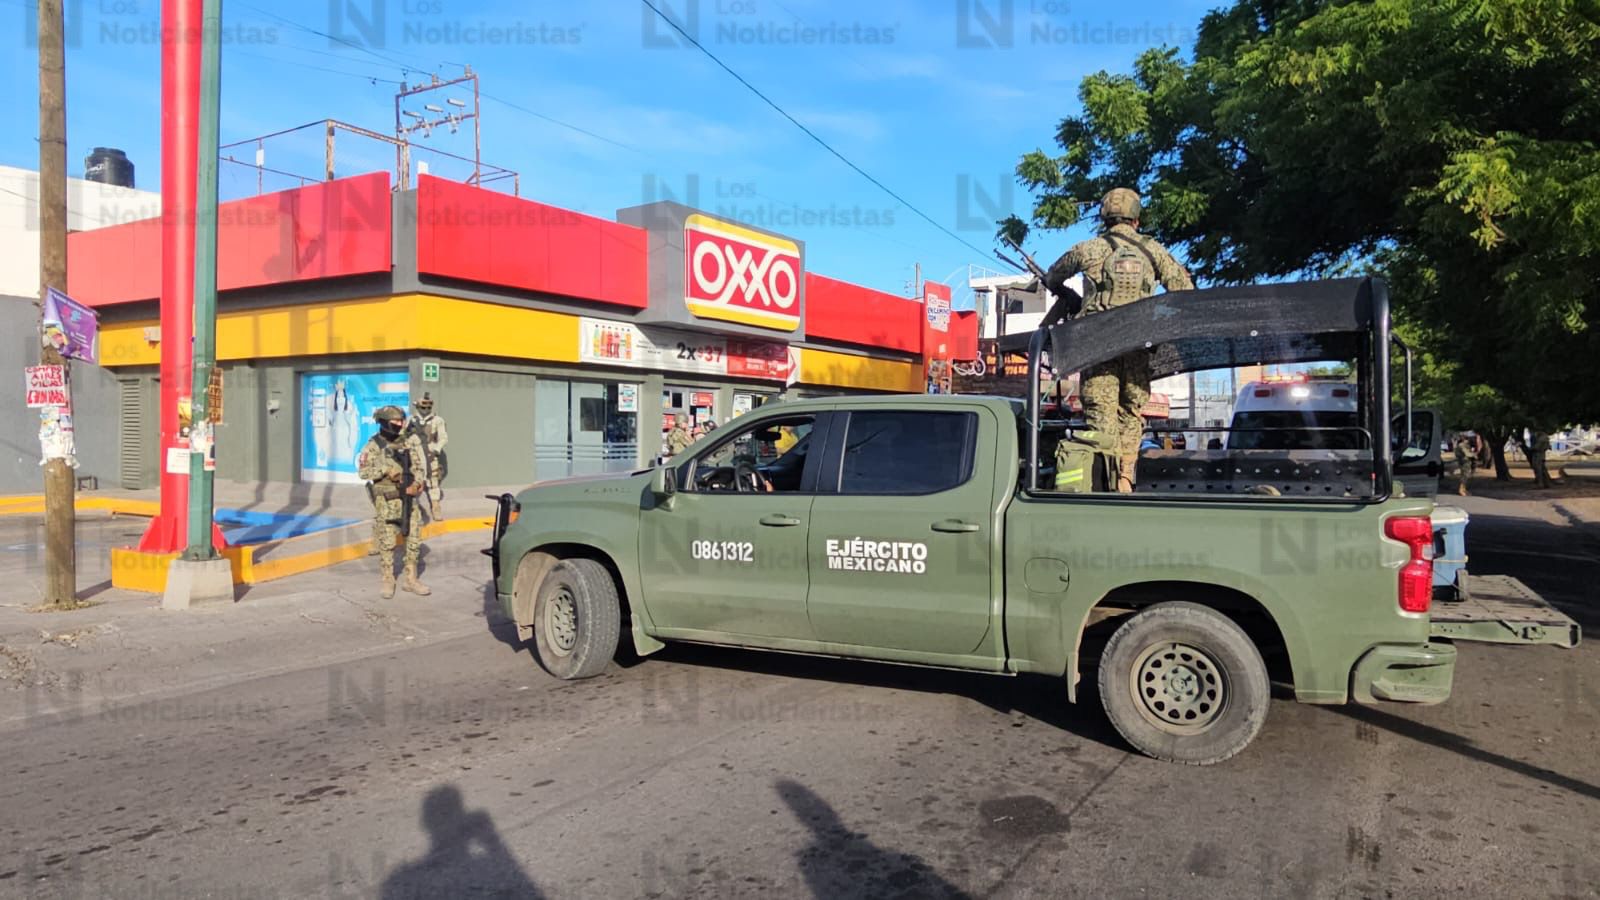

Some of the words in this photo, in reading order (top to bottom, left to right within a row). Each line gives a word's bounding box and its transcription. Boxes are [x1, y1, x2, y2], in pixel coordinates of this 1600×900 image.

[692, 239, 797, 309] OXXO
[691, 540, 754, 562] 0861312
[826, 537, 927, 560] EJÉRCITO
[828, 556, 927, 574] MEXICANO
